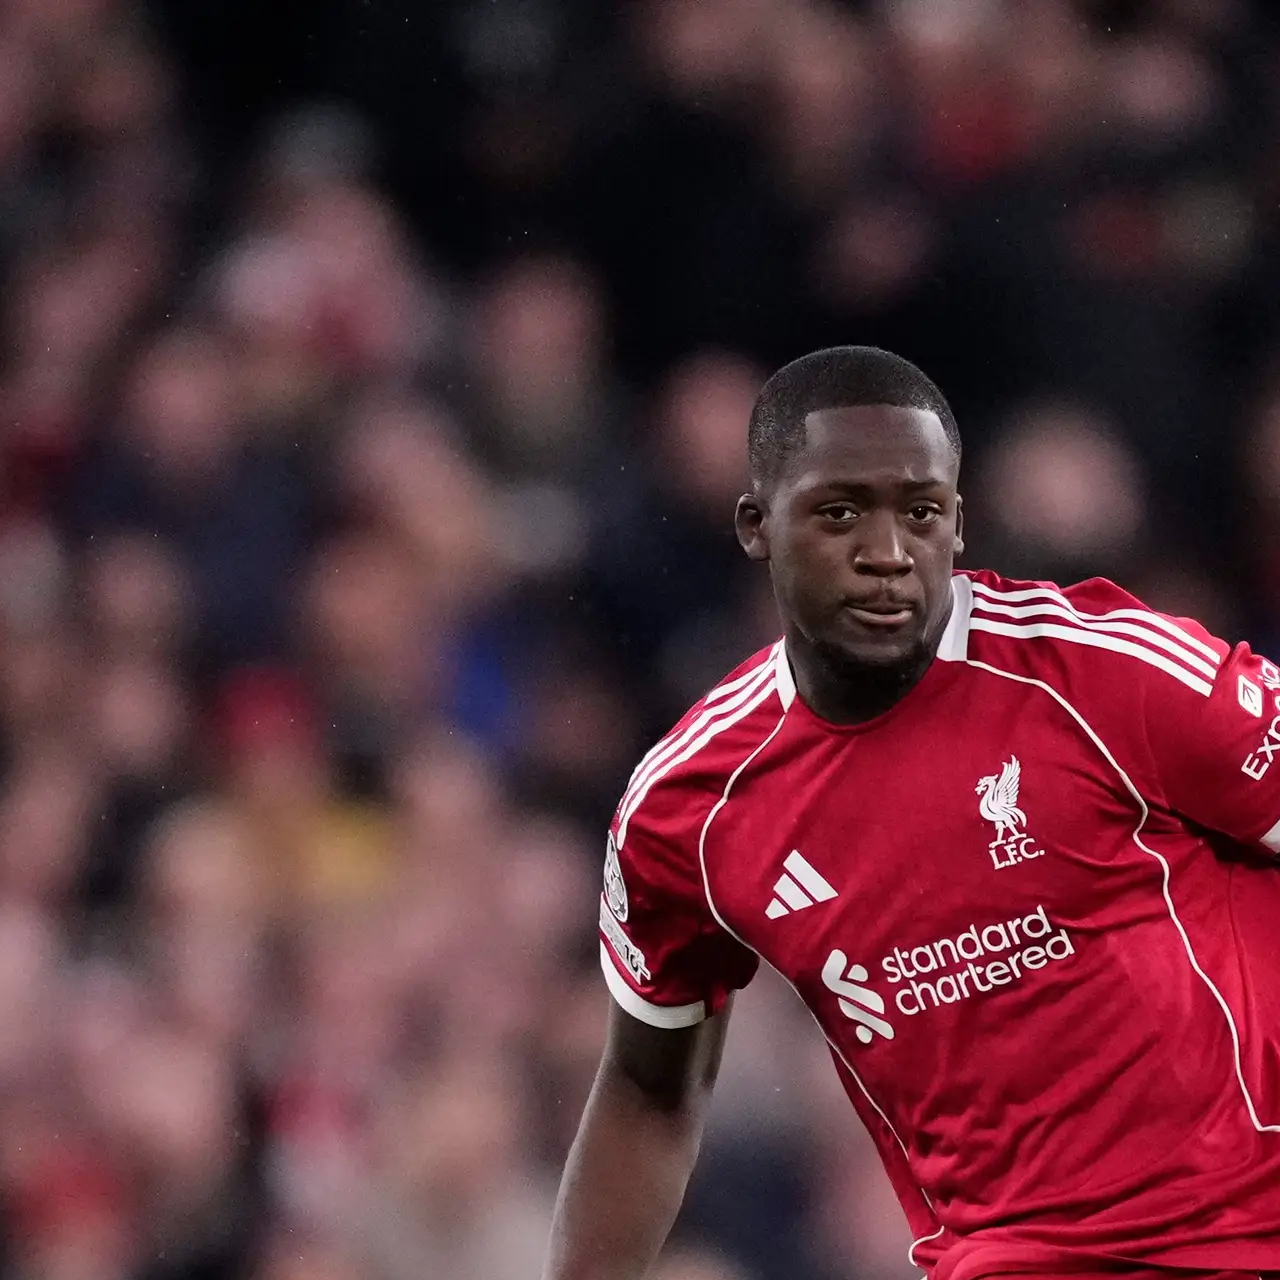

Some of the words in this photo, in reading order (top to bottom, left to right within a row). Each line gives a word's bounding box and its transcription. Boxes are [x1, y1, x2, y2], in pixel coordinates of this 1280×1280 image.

[988, 838, 1046, 870] L.F.C.
[881, 904, 1052, 984] standard
[895, 928, 1075, 1016] chartered
